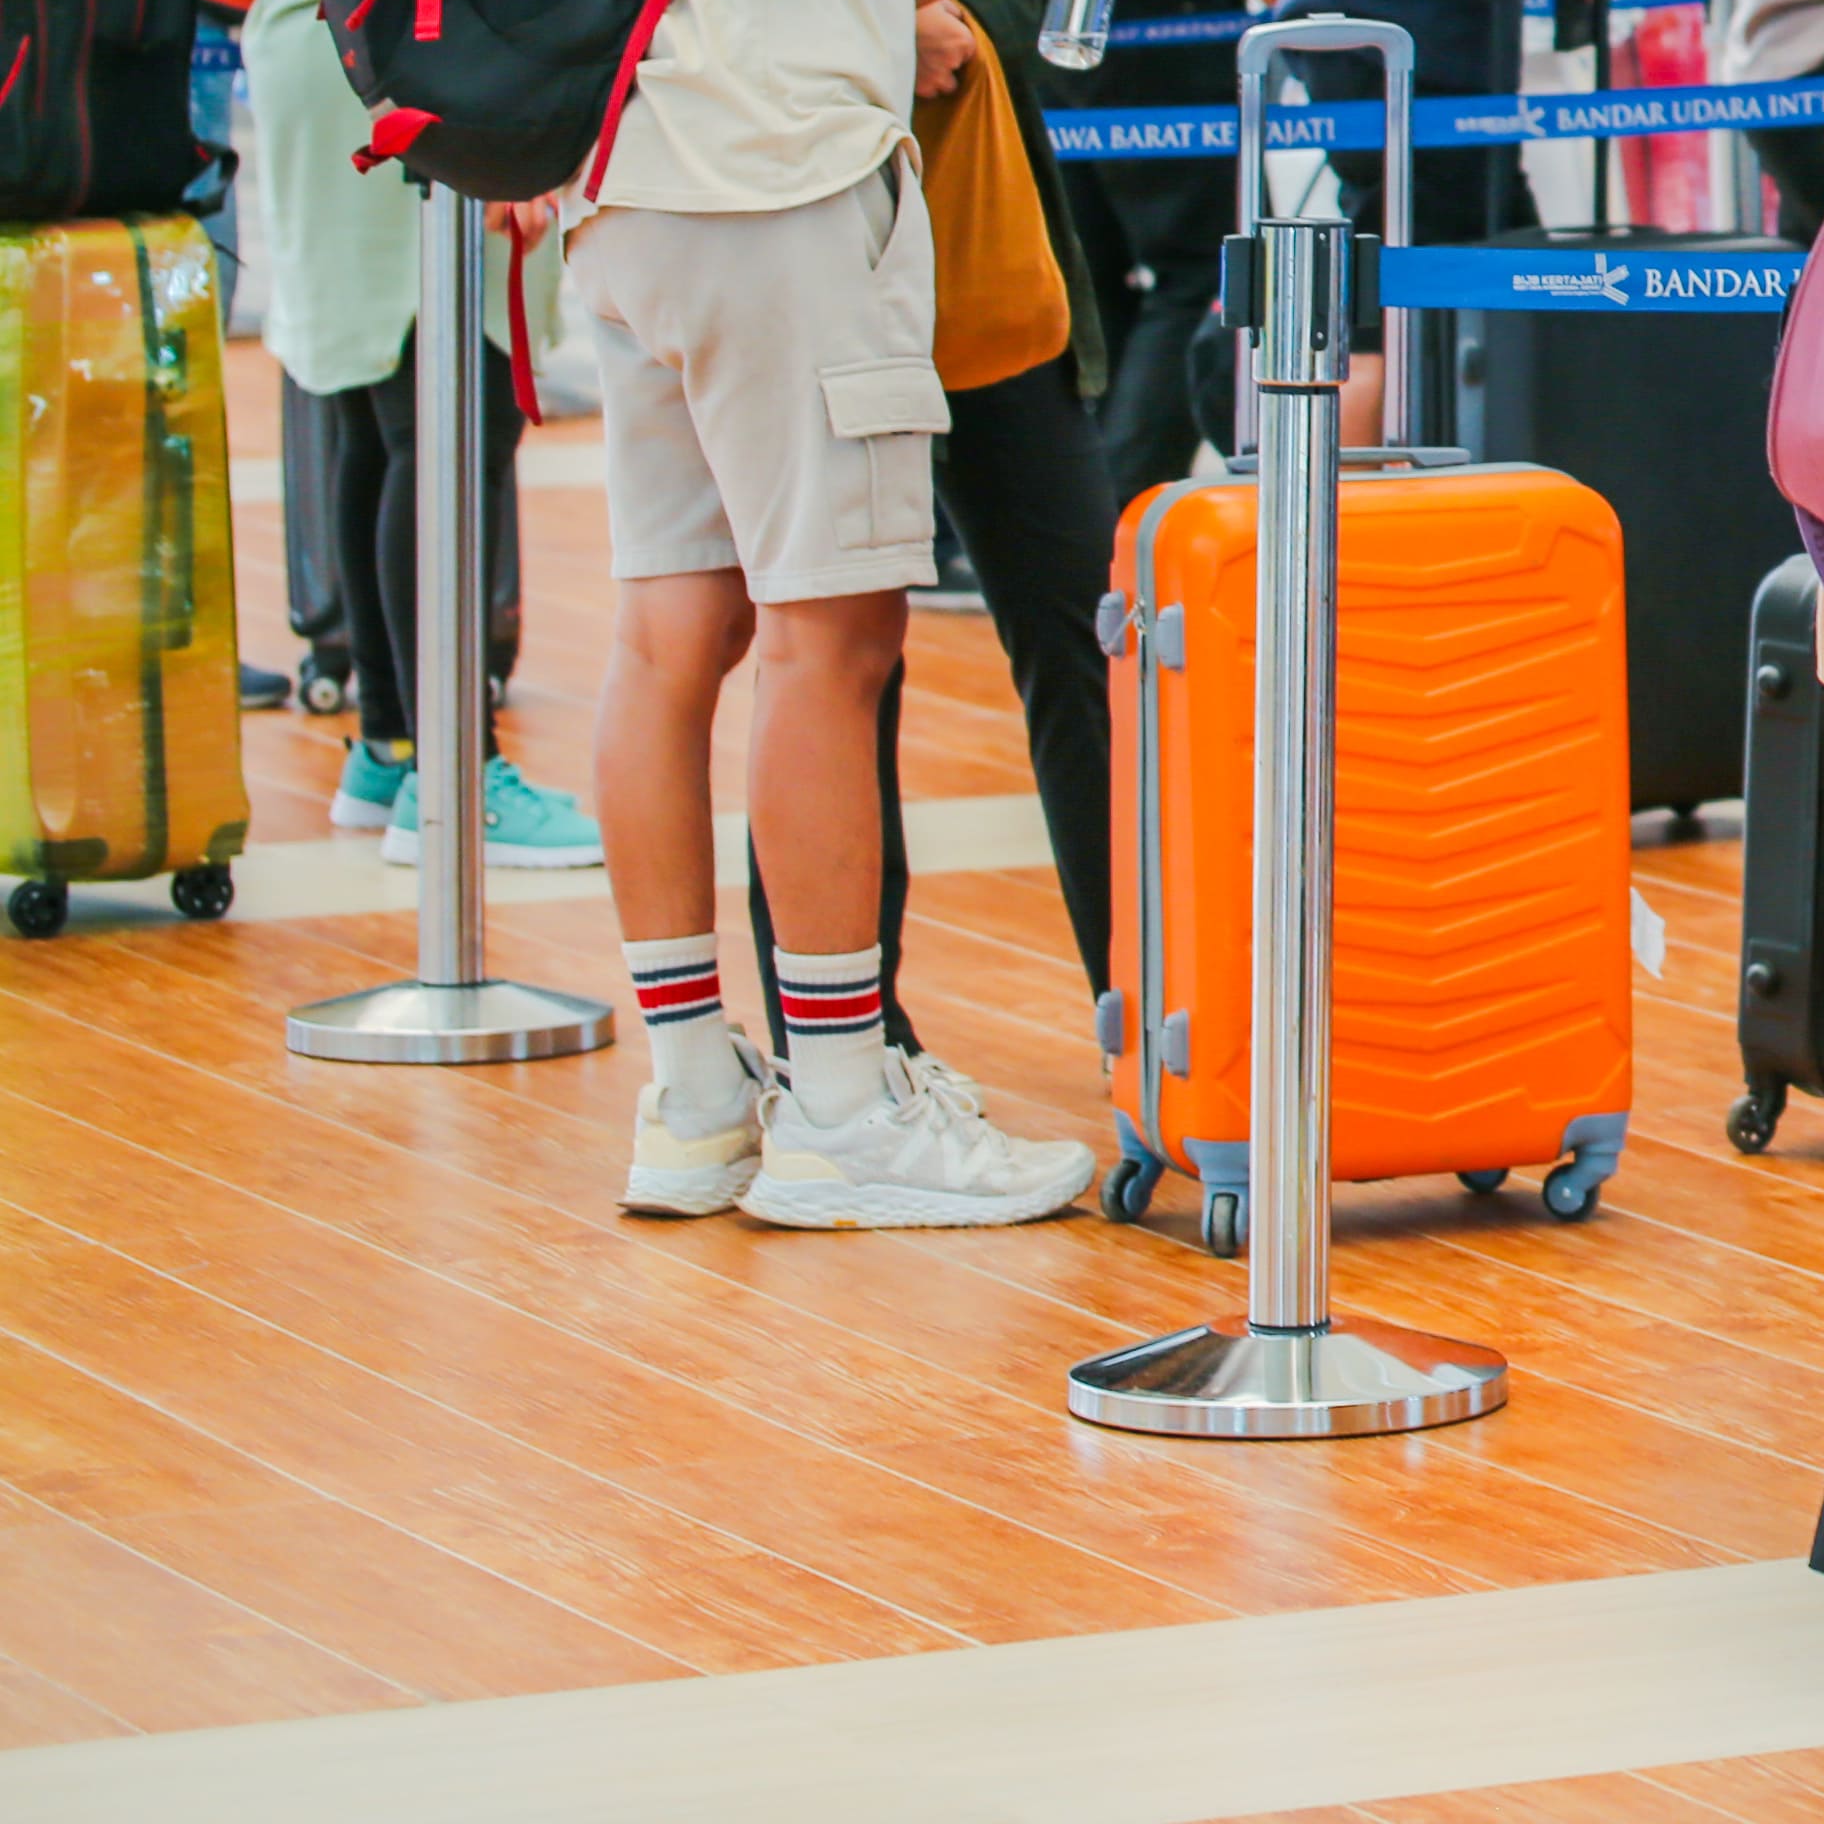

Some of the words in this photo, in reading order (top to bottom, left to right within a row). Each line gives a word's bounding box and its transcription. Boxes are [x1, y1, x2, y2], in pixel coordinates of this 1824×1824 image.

[1557, 102, 1666, 132] BANDAR
[1671, 96, 1764, 127] UDARA
[1048, 126, 1104, 151] AWA
[1110, 123, 1195, 150] BARAT
[1202, 117, 1336, 147] KEAJATI
[1644, 268, 1787, 297] BANDAR
